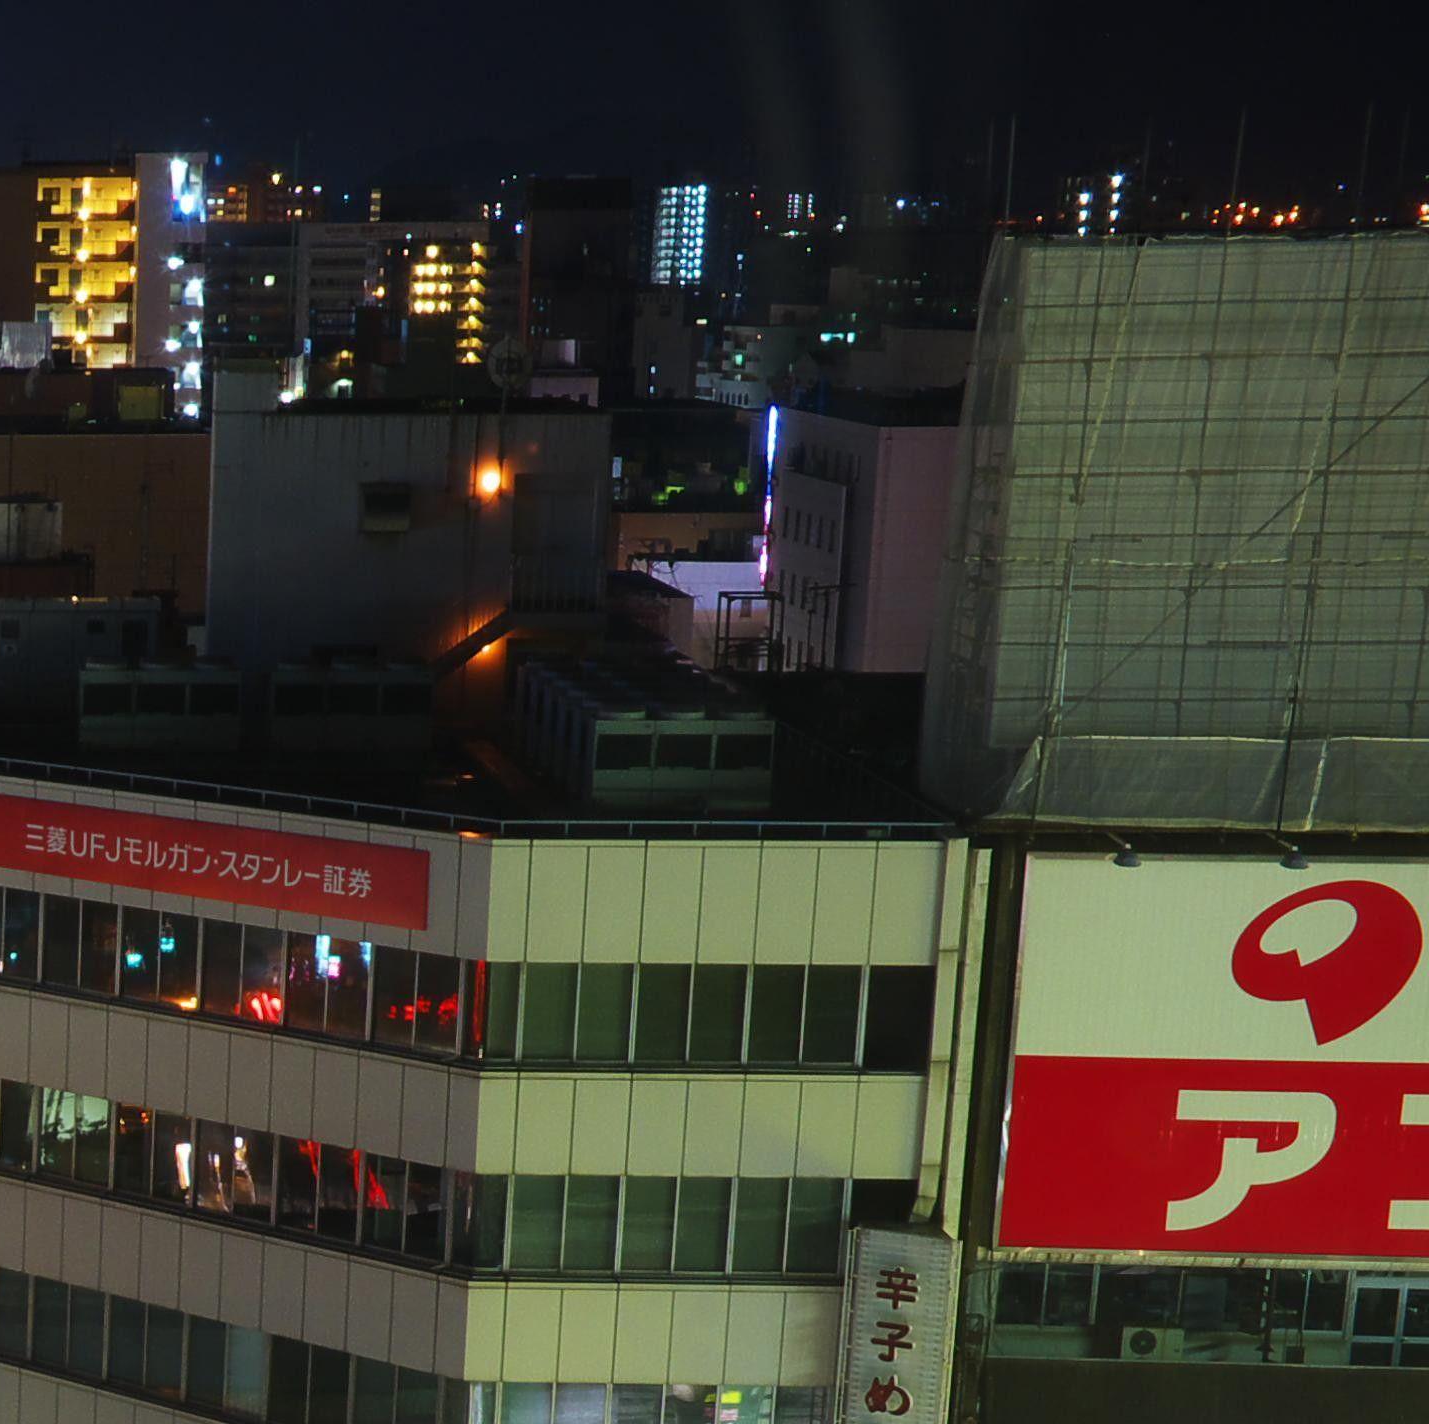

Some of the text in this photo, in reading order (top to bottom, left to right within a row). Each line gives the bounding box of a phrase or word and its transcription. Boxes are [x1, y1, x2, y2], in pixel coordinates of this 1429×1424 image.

[25, 822, 373, 898] 三菱UFJモルガン・スタンレー証券
